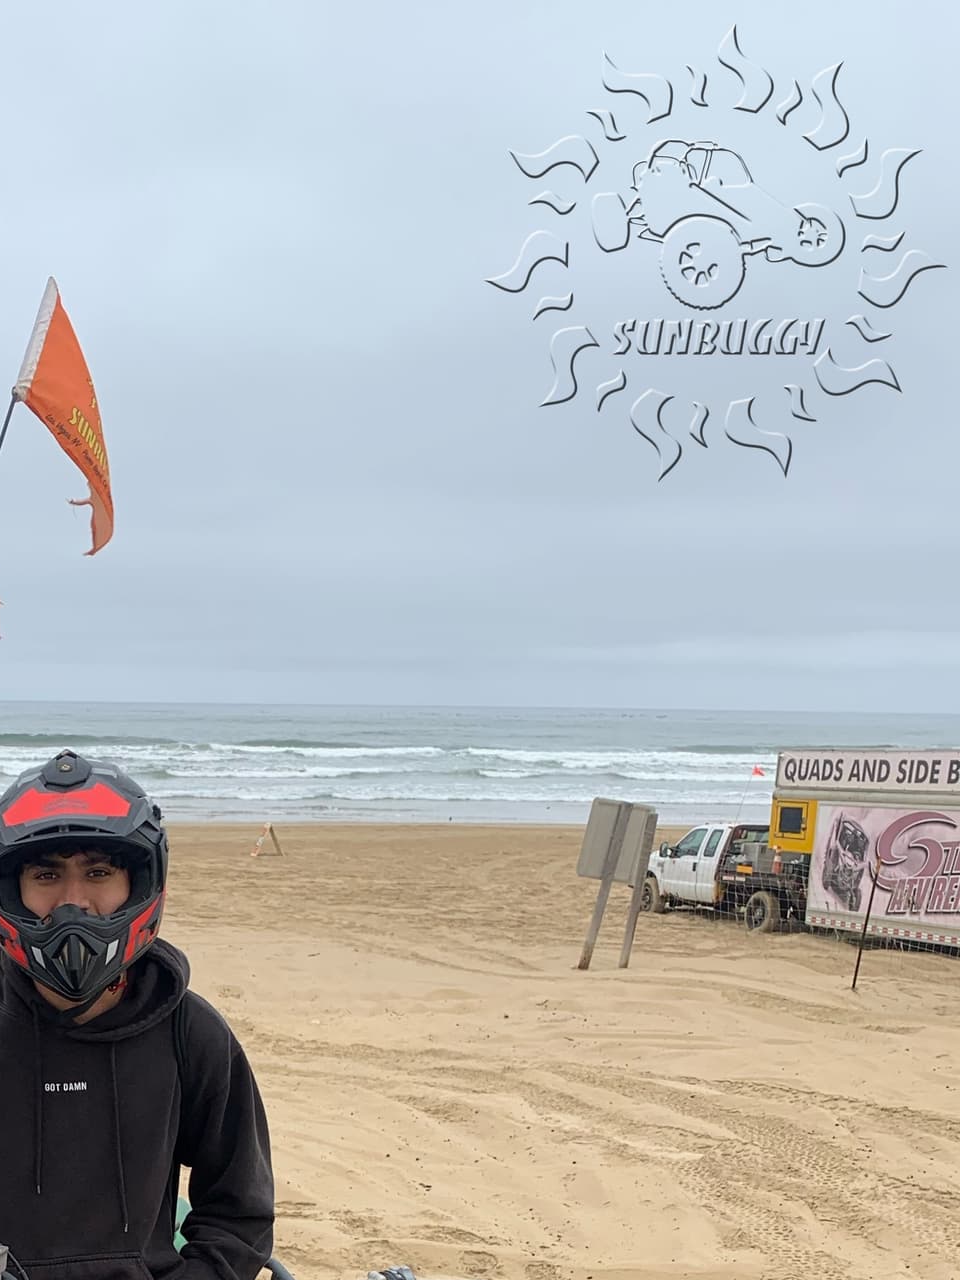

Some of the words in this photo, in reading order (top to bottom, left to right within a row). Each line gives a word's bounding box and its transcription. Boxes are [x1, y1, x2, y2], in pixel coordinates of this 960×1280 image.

[784, 758, 844, 783] QUADS
[848, 759, 890, 783] AND
[896, 760, 941, 784] SIDE
[926, 876, 960, 914] RE
[44, 1083, 61, 1092] GOT
[63, 1081, 87, 1092] DAMN
